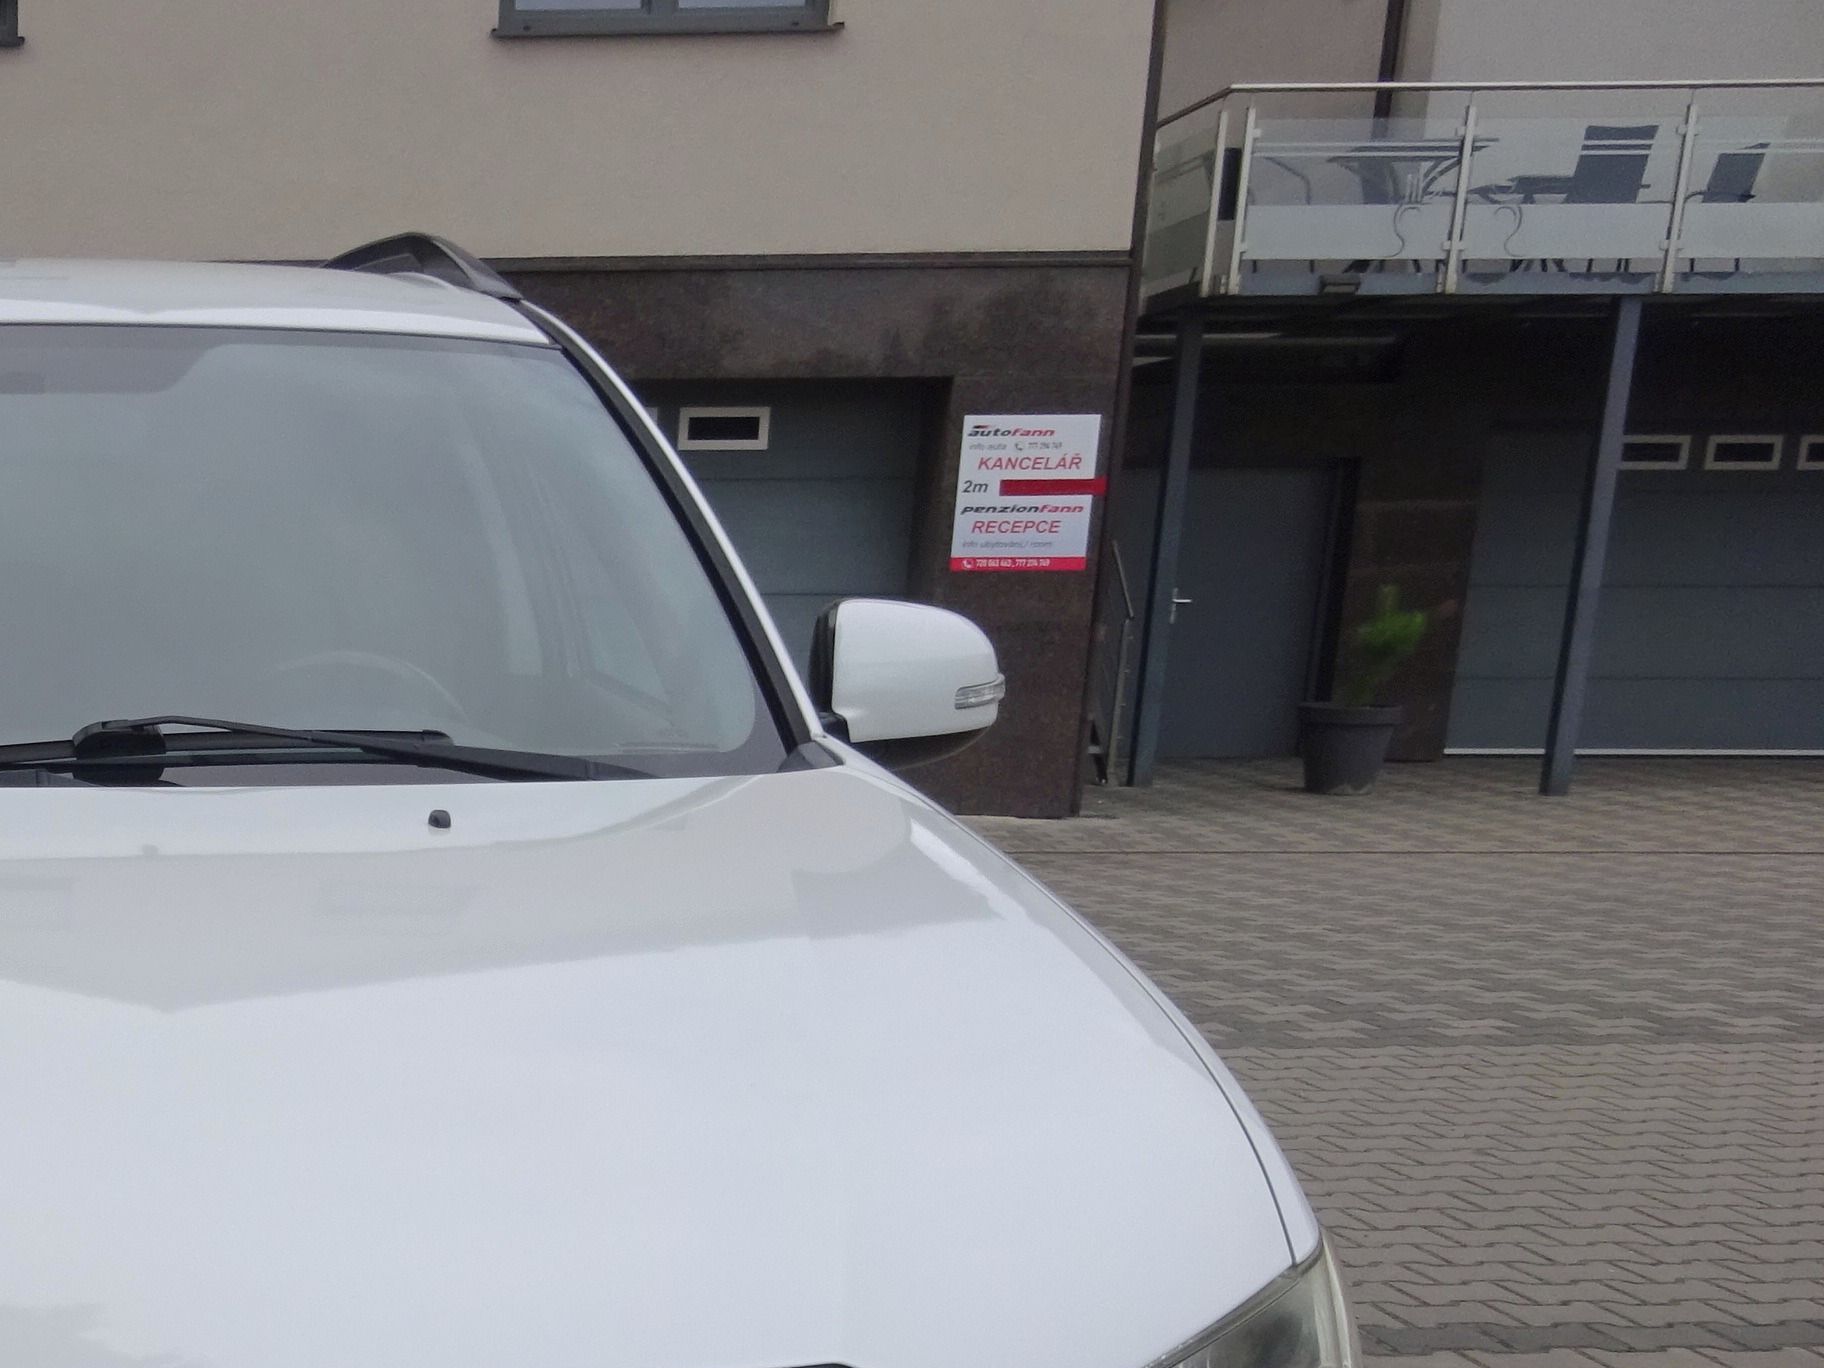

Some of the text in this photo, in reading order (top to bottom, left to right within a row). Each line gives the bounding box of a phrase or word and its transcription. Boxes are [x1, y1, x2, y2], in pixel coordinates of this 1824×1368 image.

[968, 426, 1055, 437] autofann
[978, 453, 1082, 470] KANCELÁŘ
[962, 480, 988, 493] 2m
[960, 504, 1084, 516] penzionfann
[971, 520, 1062, 534] RECEPCE
